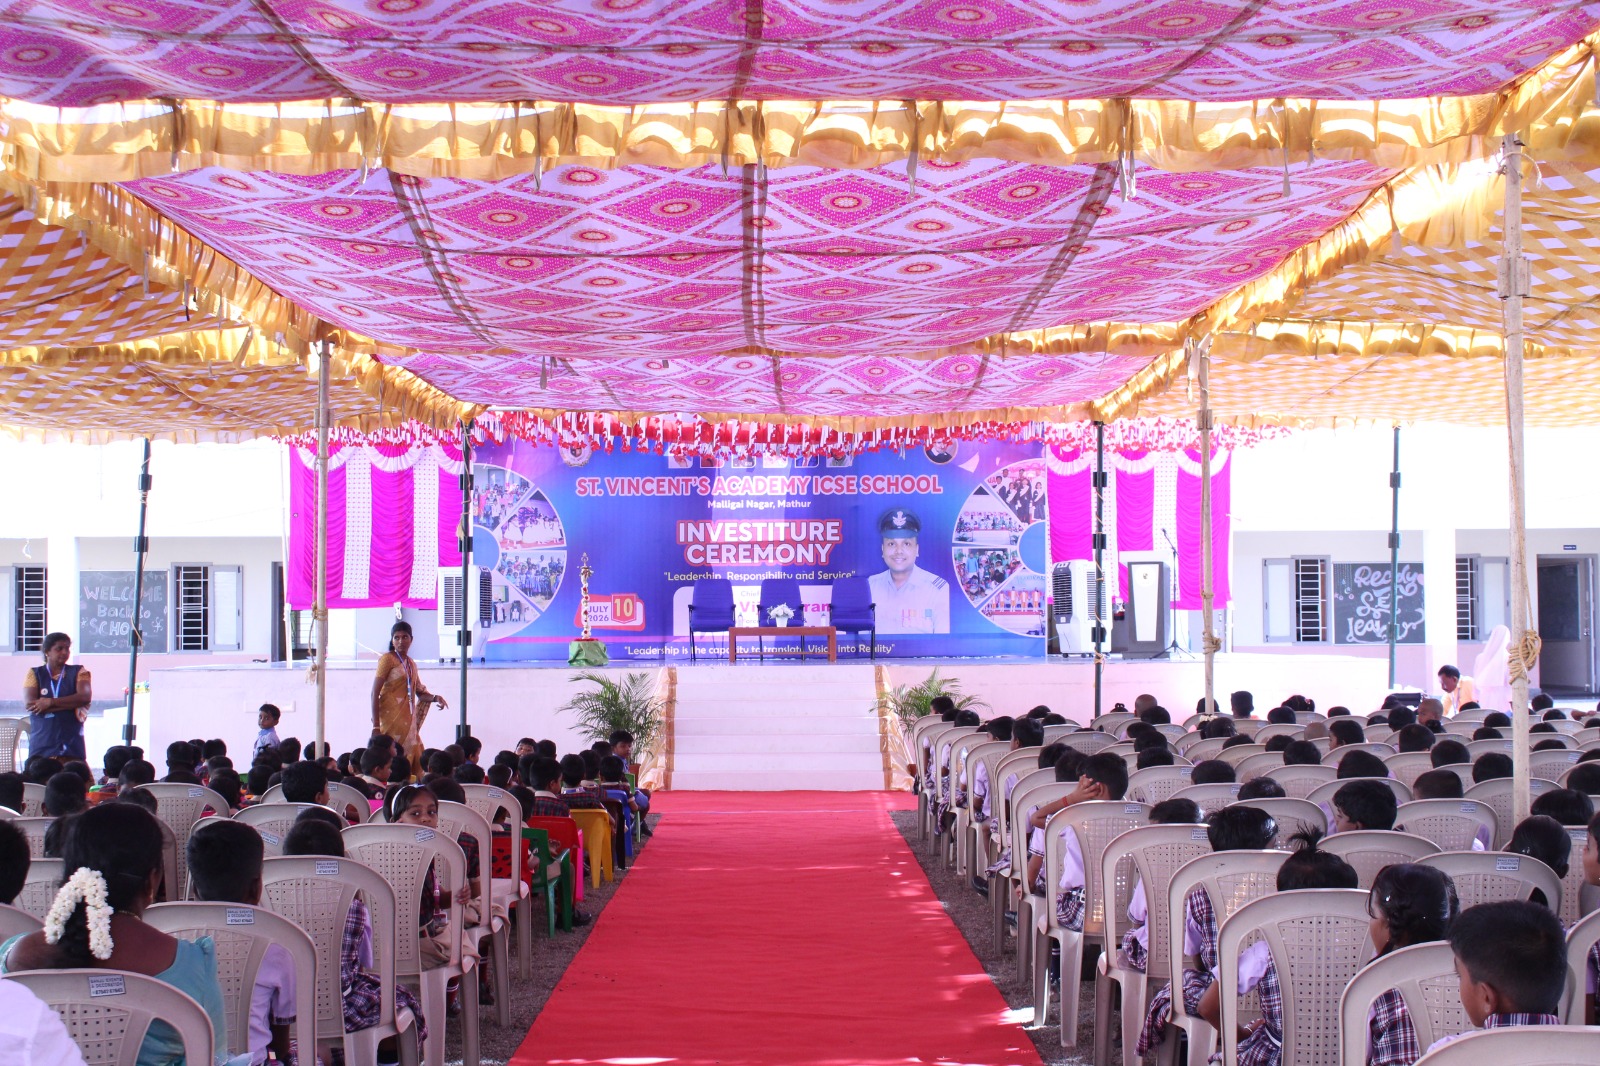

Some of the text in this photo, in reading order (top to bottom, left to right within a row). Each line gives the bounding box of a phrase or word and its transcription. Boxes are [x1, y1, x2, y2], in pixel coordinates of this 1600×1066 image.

[576, 474, 943, 496] ST. VINCENT'S ACADEMY ICSE SCHOOL
[707, 500, 811, 510] Malligai Nagar, Mathur
[679, 521, 840, 542] INVESTITURE
[686, 543, 832, 564] CEREMONY
[795, 570, 814, 580] and
[588, 598, 633, 617] JULY 10
[588, 614, 609, 622] 2026
[624, 646, 680, 656] "Leadership
[682, 646, 689, 654] is
[837, 644, 856, 653] into
